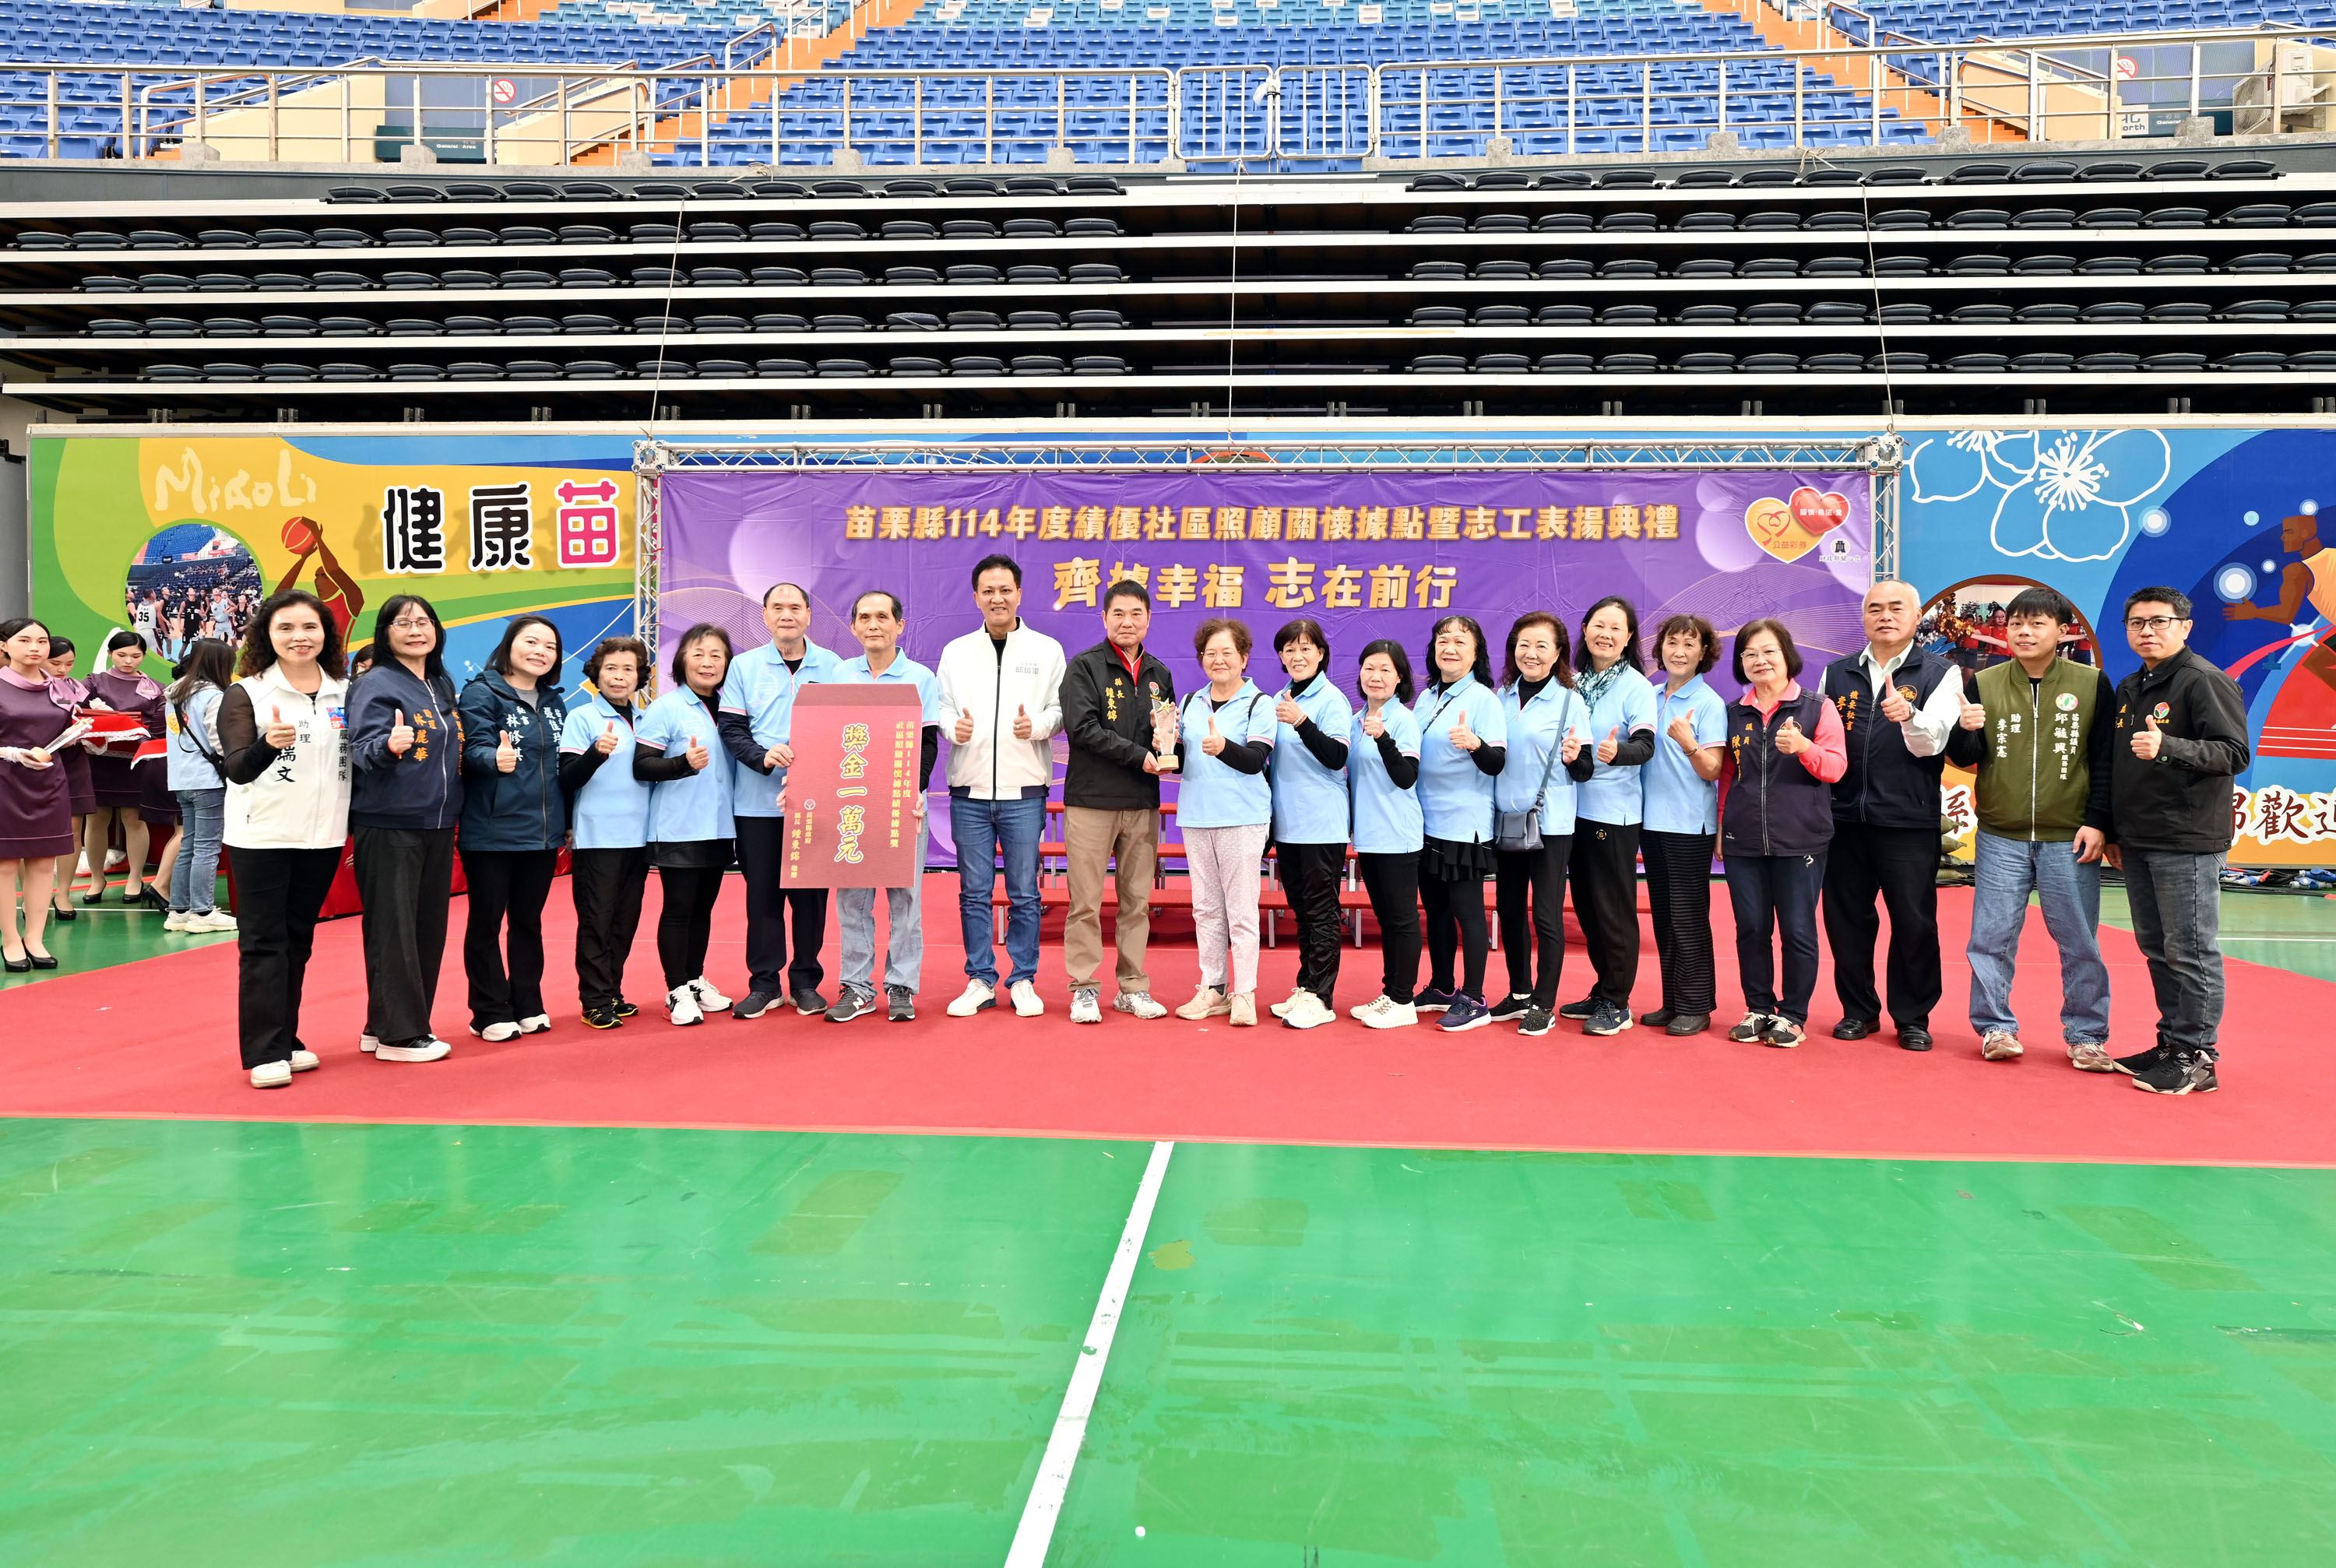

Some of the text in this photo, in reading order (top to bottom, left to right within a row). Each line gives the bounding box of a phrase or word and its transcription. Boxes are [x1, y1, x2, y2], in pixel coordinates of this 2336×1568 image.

[380, 479, 620, 573] 健康苗
[845, 503, 1680, 541] 苗栗縣114年度績優社區照顧關懷據點暨志工表揚典禮
[1264, 556, 1458, 609] 志在前行
[138, 612, 150, 622] 35
[834, 723, 870, 863] 獎金一萬元
